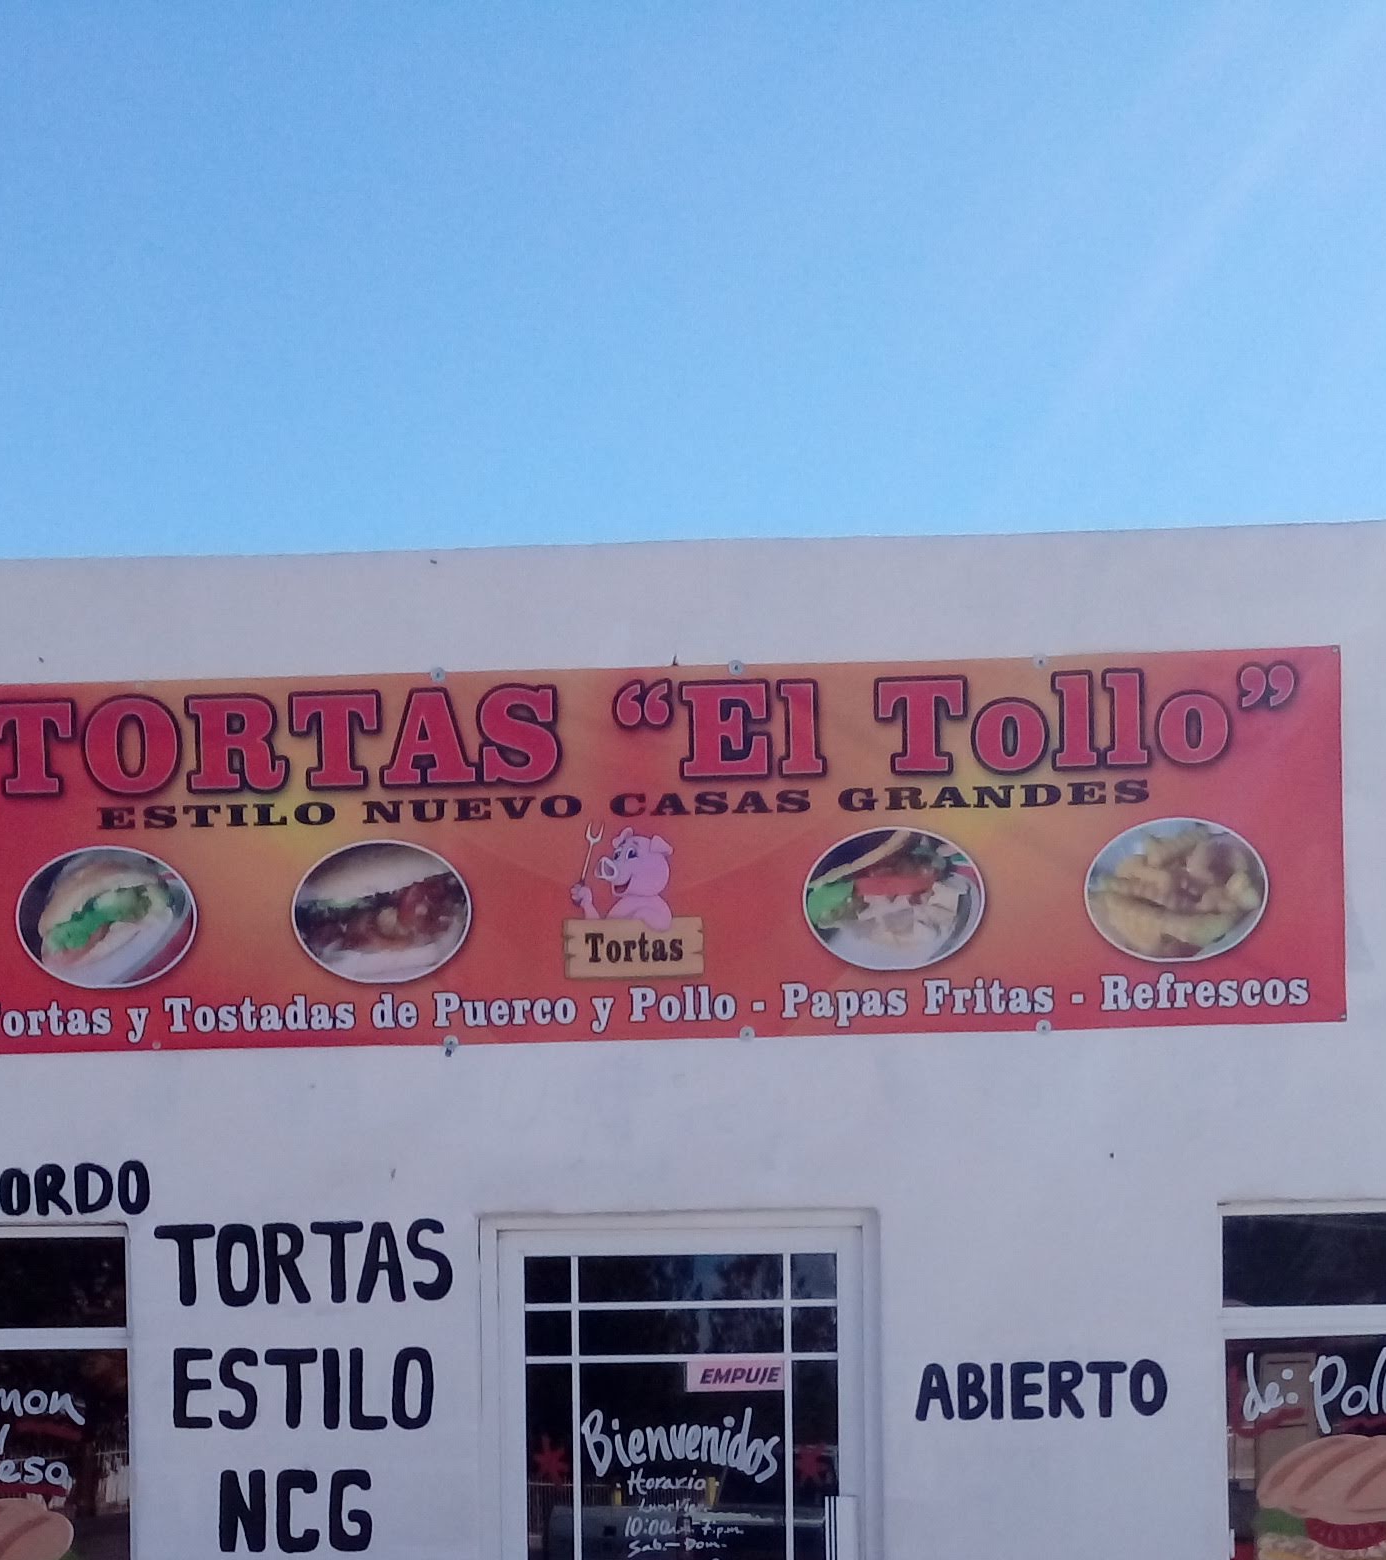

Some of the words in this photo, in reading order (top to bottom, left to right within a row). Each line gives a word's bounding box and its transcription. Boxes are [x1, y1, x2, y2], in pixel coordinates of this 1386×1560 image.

[98, 801, 337, 831] ESTILO
[362, 794, 582, 824] NUEVO
[610, 787, 811, 817] CASAS
[838, 779, 1151, 813] GRANDES
[584, 931, 685, 963] Tortas
[127, 1006, 149, 1036] y
[164, 993, 355, 1033] Tostadas
[371, 992, 417, 1029] de
[433, 990, 577, 1028] Puerco
[590, 996, 614, 1032] y
[629, 984, 737, 1024] Pollo
[780, 980, 908, 1028] Papas
[922, 977, 1055, 1016] Fritas
[1100, 972, 1310, 1012] Refrescos
[154, 1218, 453, 1307] TORTAS
[173, 1346, 434, 1430] ESTILO
[700, 1367, 782, 1385] EMPUJE
[915, 1359, 1168, 1421] ABIERTO
[1243, 1352, 1299, 1421] de:
[581, 1407, 781, 1484] Bienvenidos
[219, 1469, 373, 1554] NCG
